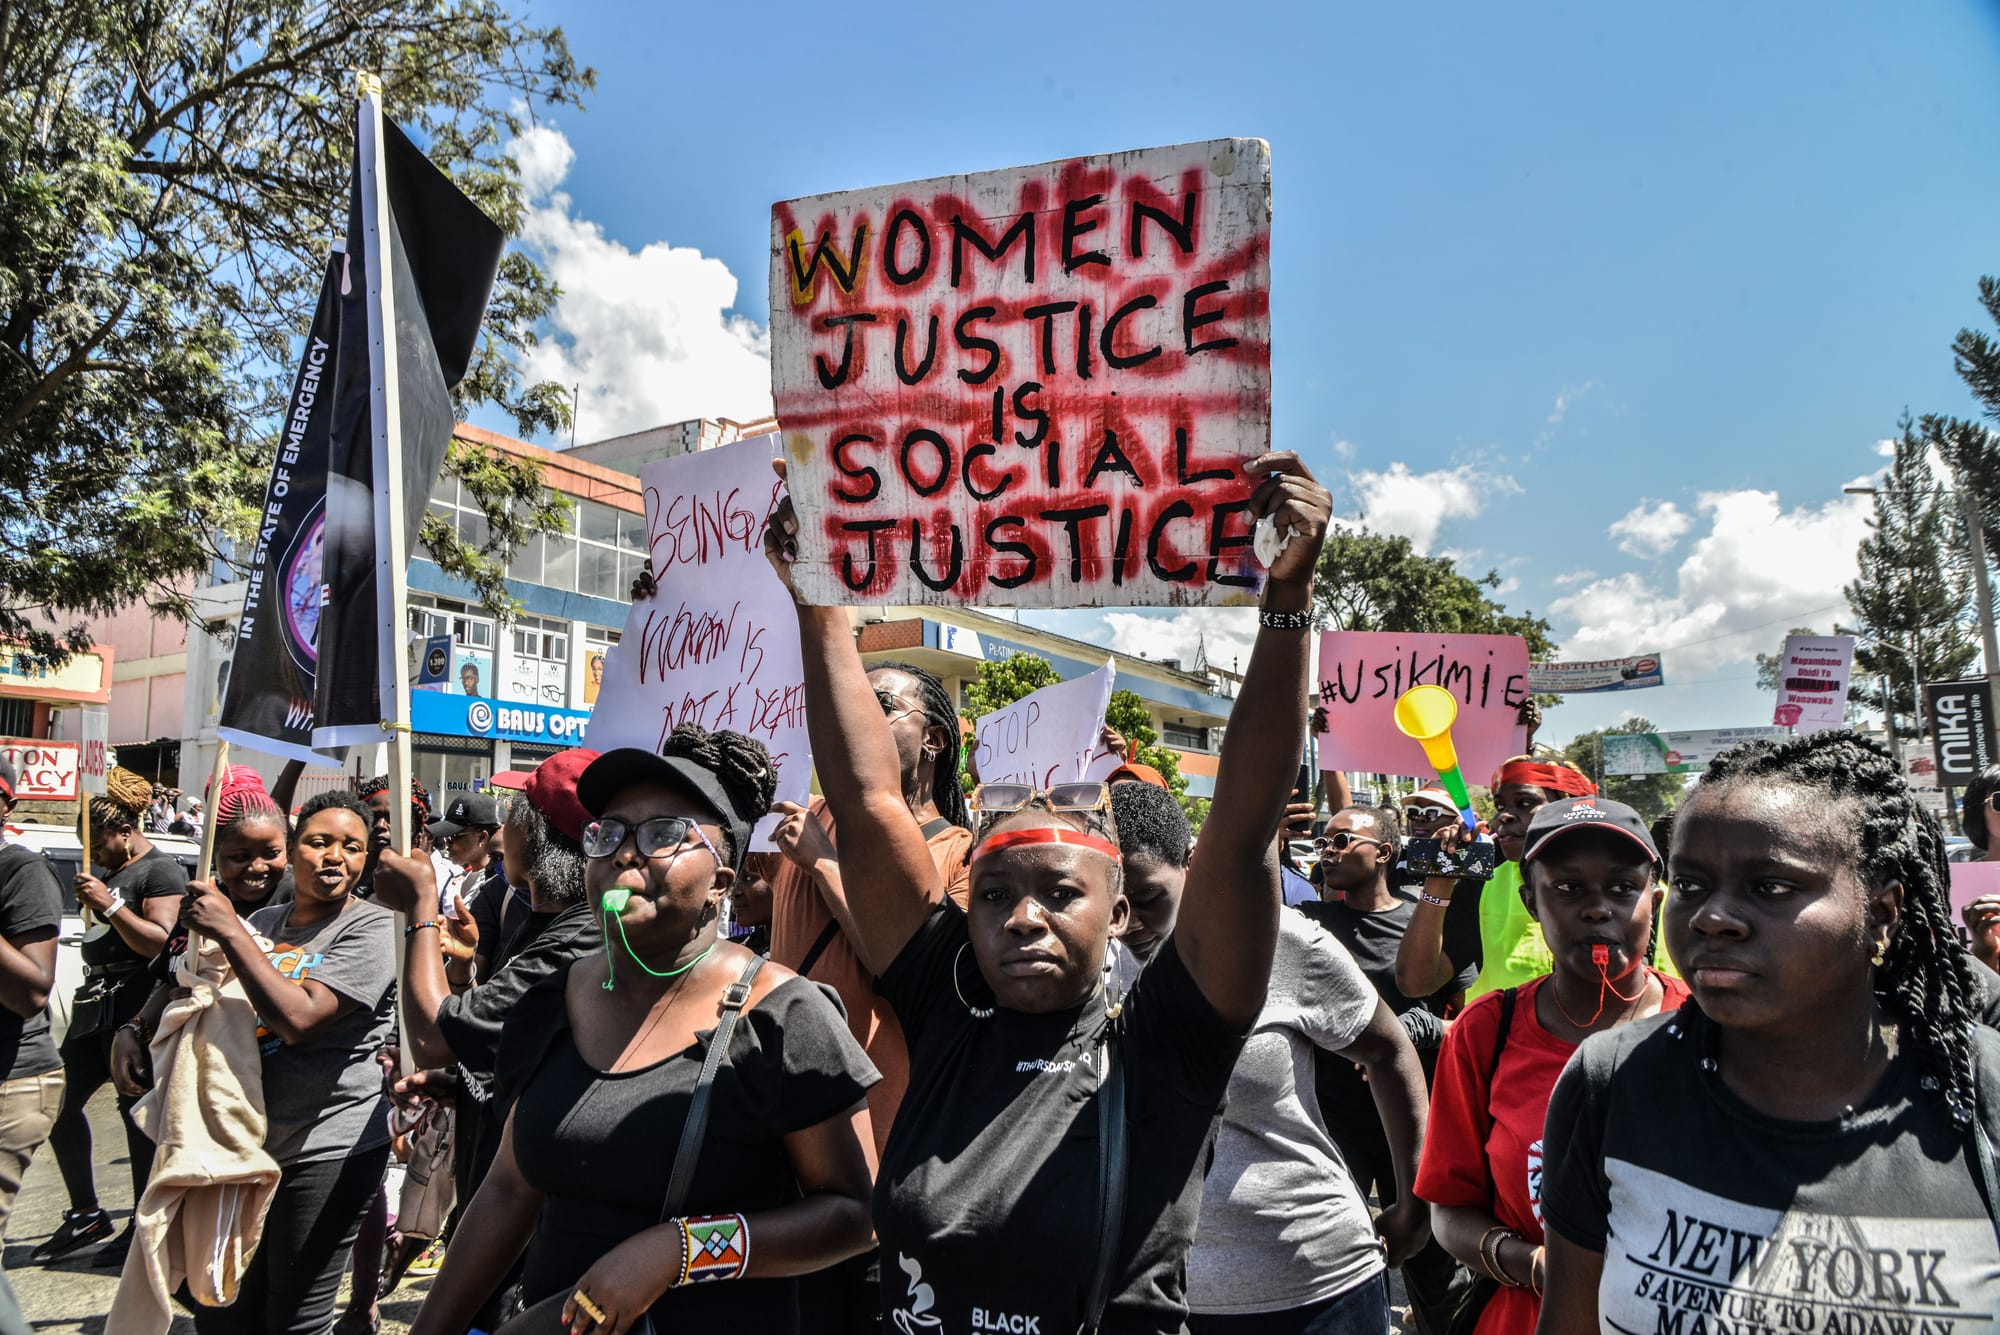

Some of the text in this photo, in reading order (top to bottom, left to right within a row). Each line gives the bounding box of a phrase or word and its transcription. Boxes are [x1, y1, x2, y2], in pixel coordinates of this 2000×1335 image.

[788, 193, 1196, 296] WOMEN
[815, 280, 1239, 390] JUSTICE
[991, 381, 1050, 449] IS
[240, 335, 330, 640] IN THE STATE OF EMERGENCY
[833, 428, 1236, 503] SOCIAL
[644, 486, 755, 582] BEING
[841, 499, 1260, 592] JUSTICE
[640, 601, 767, 685] WOMAN IS
[1545, 657, 1634, 671] INSTITUTE
[497, 708, 545, 734] BAUS
[713, 682, 740, 730] A
[1970, 693, 1981, 708] life
[1972, 709, 1983, 722] for
[1, 747, 59, 768] TON
[981, 701, 1040, 768] STOP
[17, 768, 74, 787] ACY
[1648, 1208, 1961, 1309] NEW YORK
[971, 1306, 1041, 1335] BLACK
[1775, 1301, 1816, 1333] TO
